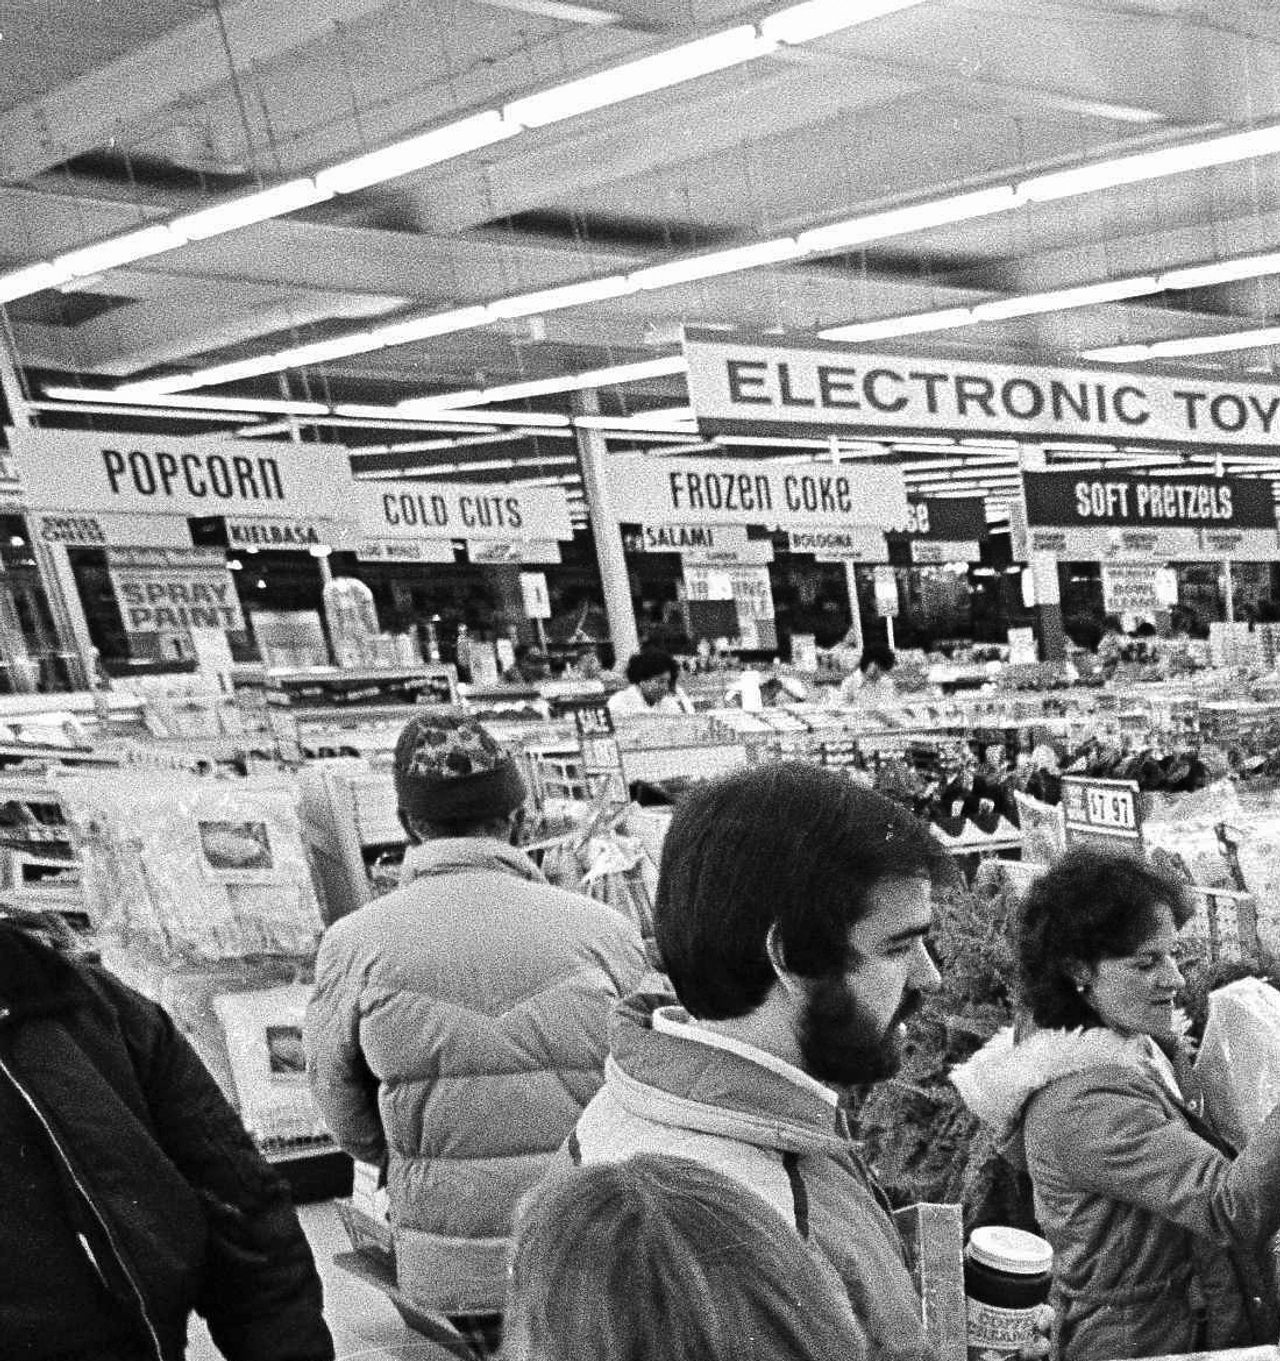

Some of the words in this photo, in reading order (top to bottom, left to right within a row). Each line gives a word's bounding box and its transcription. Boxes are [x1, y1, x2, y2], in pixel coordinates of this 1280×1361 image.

[726, 358, 1151, 426] ELECTRONIC
[103, 450, 284, 499] POPCORN
[383, 494, 449, 526] COLD
[460, 496, 522, 527] CUTS
[1076, 482, 1127, 517] SOFT
[230, 524, 320, 544] KIELBASA
[646, 527, 714, 547] SALAMI
[792, 532, 853, 548] BOLOGNA
[121, 583, 228, 605] SPRAY
[128, 606, 236, 628] PAINT
